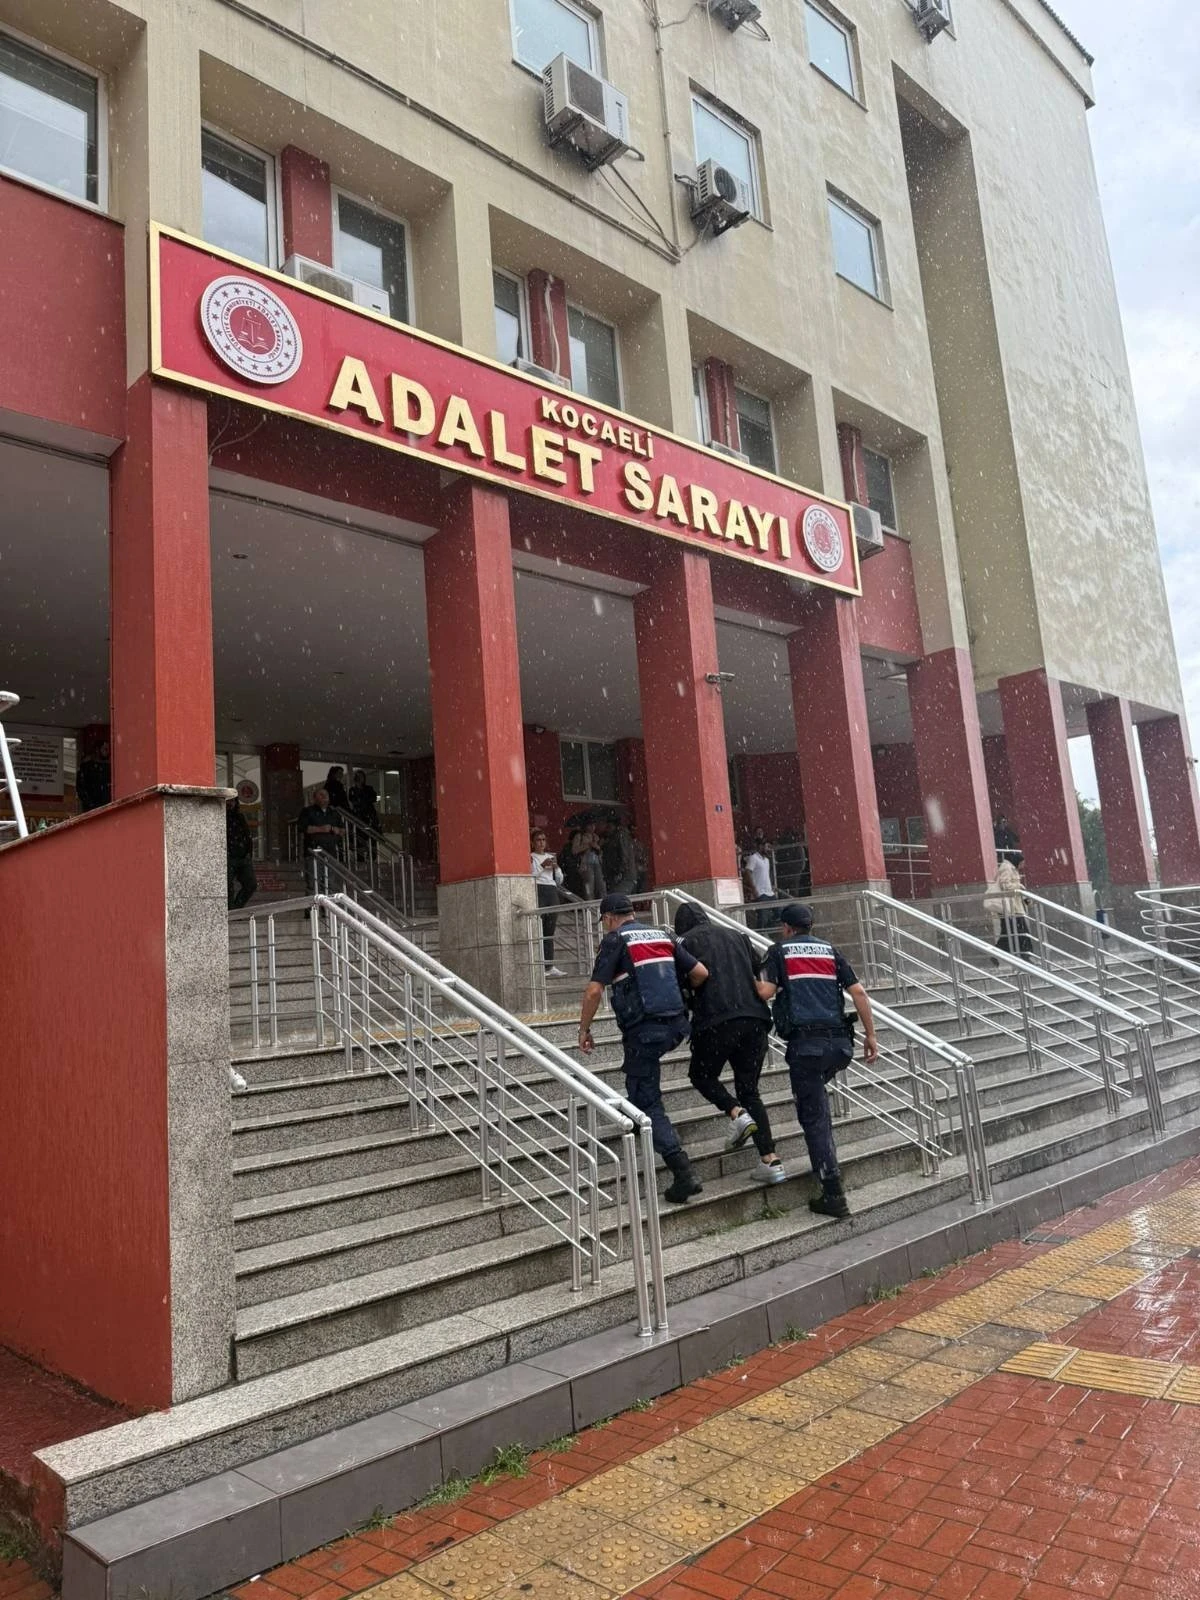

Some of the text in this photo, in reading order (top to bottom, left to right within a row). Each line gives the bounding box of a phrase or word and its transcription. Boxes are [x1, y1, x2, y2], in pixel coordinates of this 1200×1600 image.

[541, 395, 654, 459] KOCAELİ
[328, 355, 791, 559] ADALET SARAYI
[629, 931, 667, 941] JANDARMA
[787, 945, 829, 955] JANDARMA
